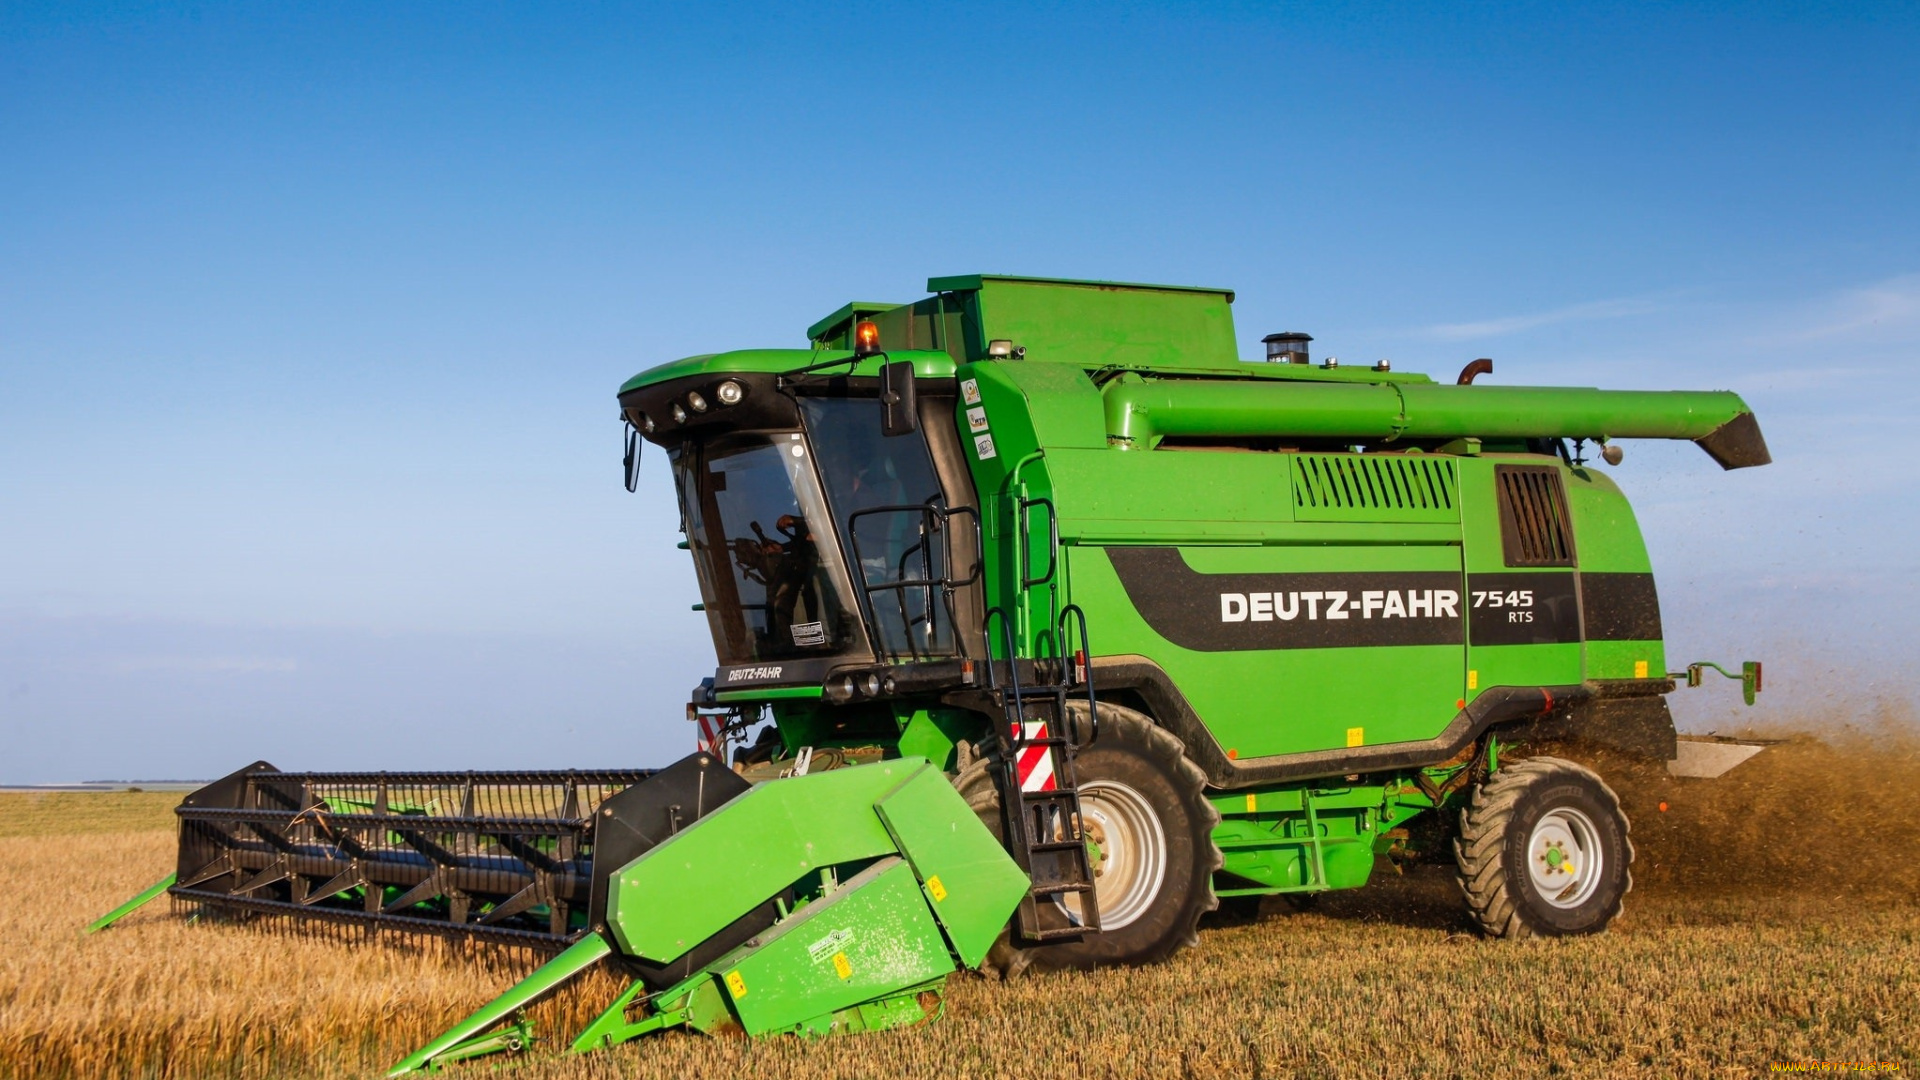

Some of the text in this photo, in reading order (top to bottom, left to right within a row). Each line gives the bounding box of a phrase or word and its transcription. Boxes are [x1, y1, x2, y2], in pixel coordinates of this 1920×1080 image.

[1220, 589, 1533, 622] DEUTZ-FAHR 7545
[1508, 611, 1534, 623] RTS
[728, 666, 783, 682] DEUTZ-FAHR
